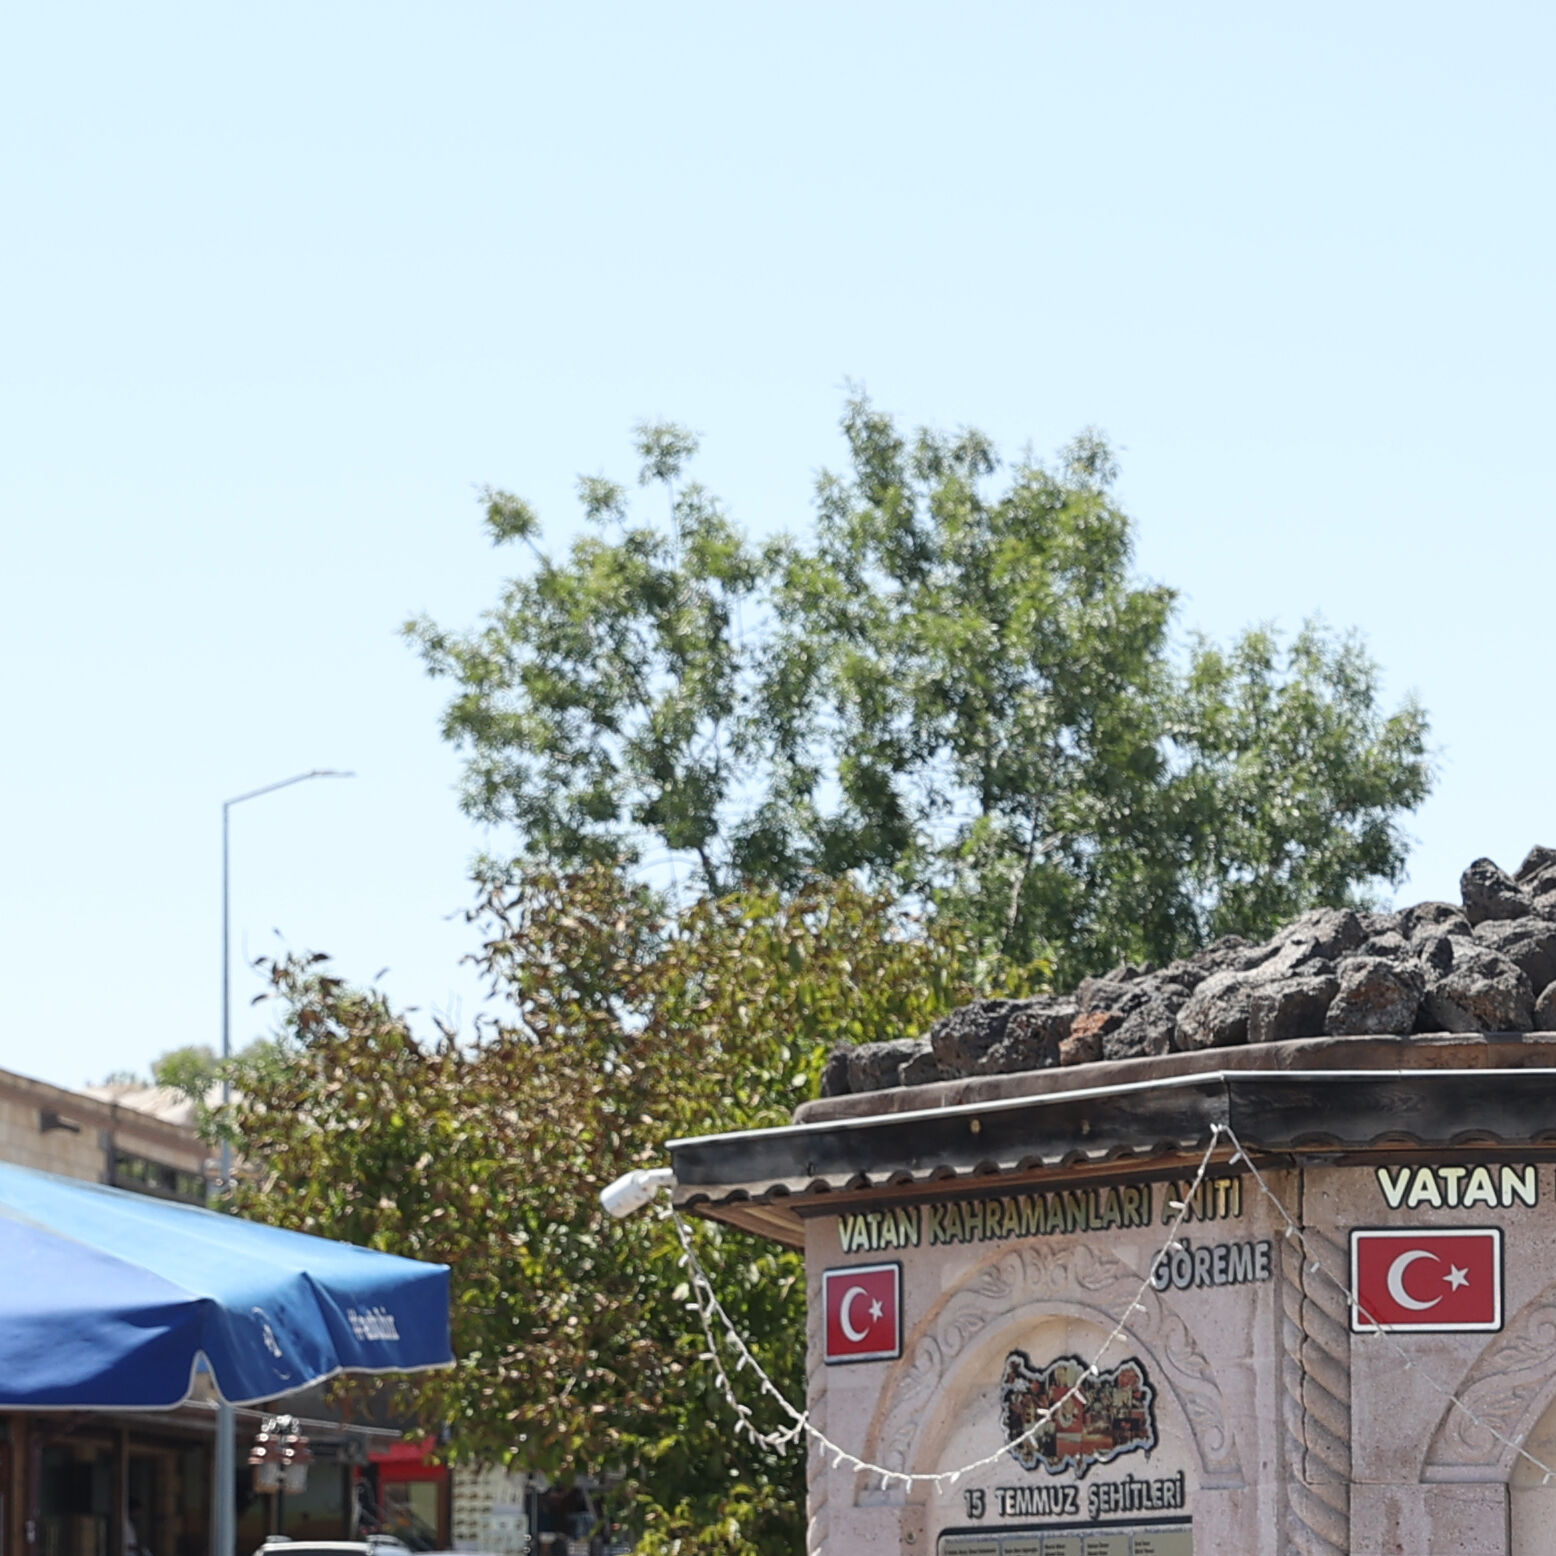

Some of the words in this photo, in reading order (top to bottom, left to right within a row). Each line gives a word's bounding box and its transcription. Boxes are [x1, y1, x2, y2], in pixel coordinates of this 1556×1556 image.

[1376, 1162, 1538, 1210] VATAN
[838, 1212, 921, 1254] VATAN
[928, 1184, 1151, 1245] KAHRAMANLARI
[1160, 1175, 1243, 1221] ANITI
[1150, 1238, 1273, 1293] GÖREME
[964, 1488, 985, 1518] 15
[994, 1481, 1079, 1517] TEMMUZ
[1088, 1469, 1185, 1521] ŞEHİTLERİ
